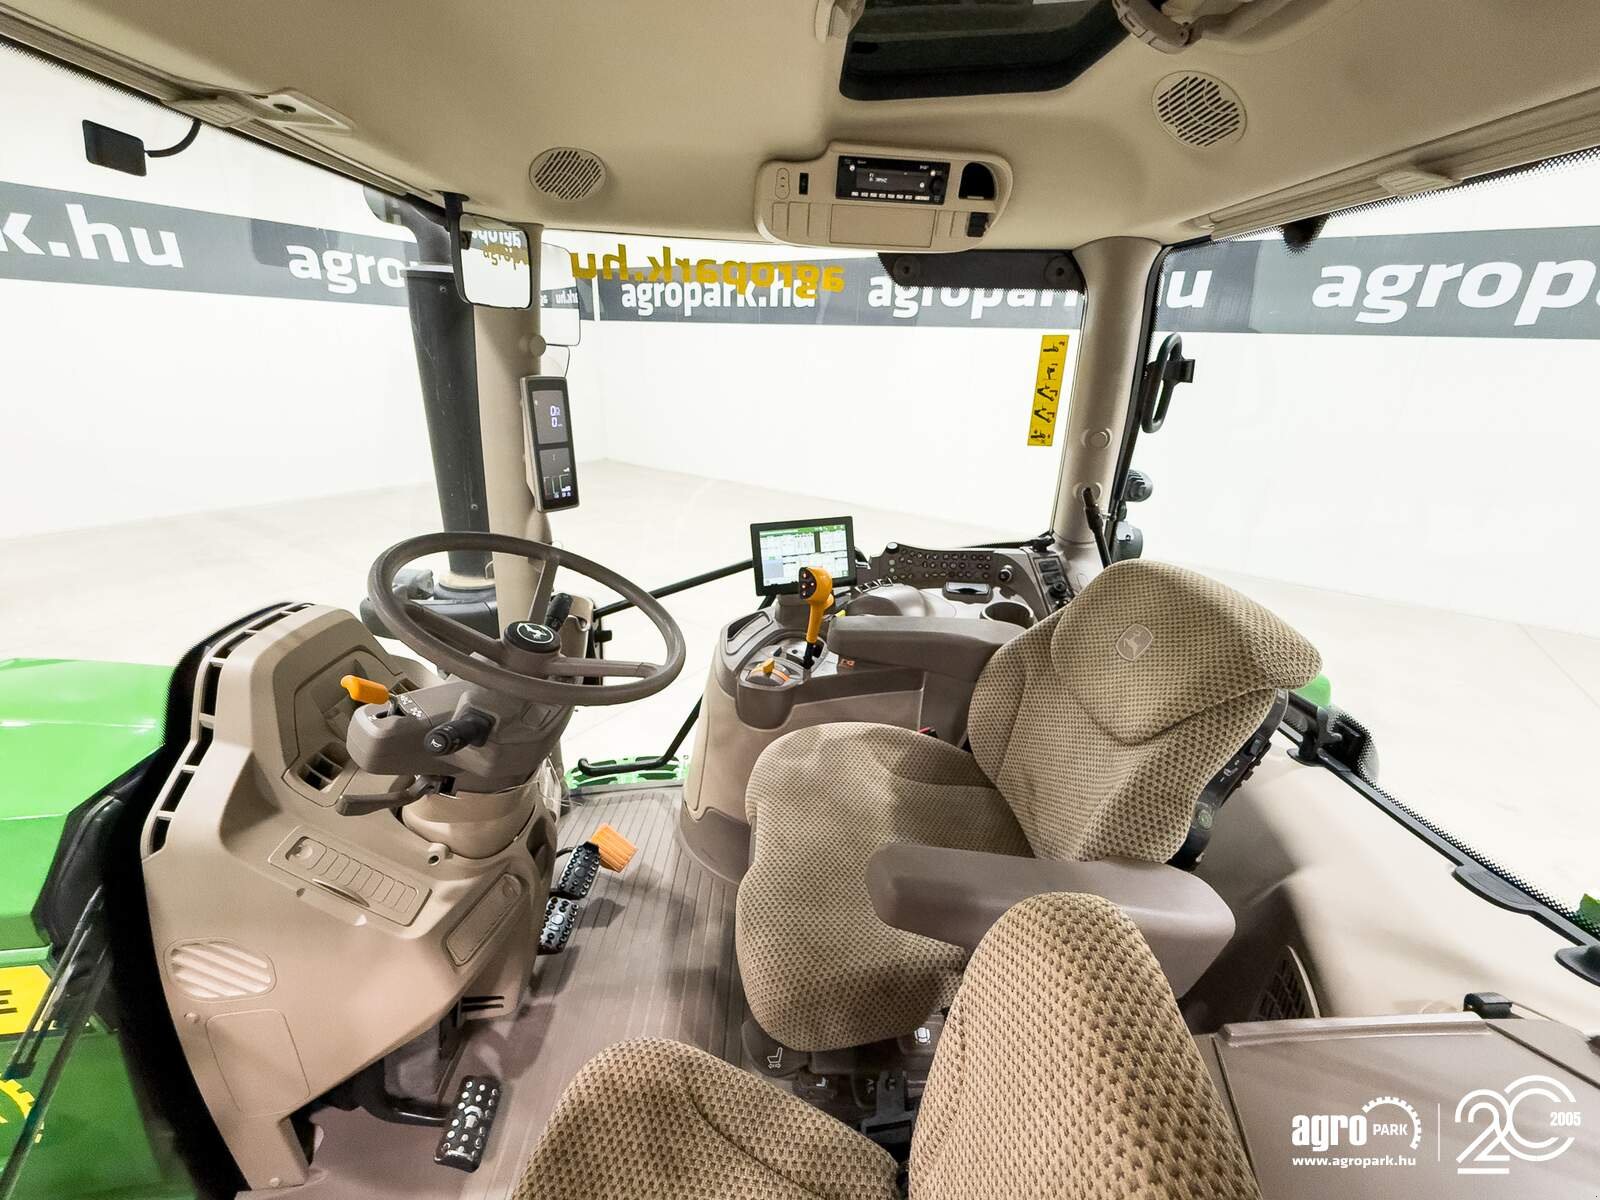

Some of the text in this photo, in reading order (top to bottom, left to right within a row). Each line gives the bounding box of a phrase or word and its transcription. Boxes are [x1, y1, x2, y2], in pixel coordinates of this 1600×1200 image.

[286, 243, 418, 294] agro
[621, 269, 816, 317] agropark.hu
[1311, 259, 1600, 325] agrop
